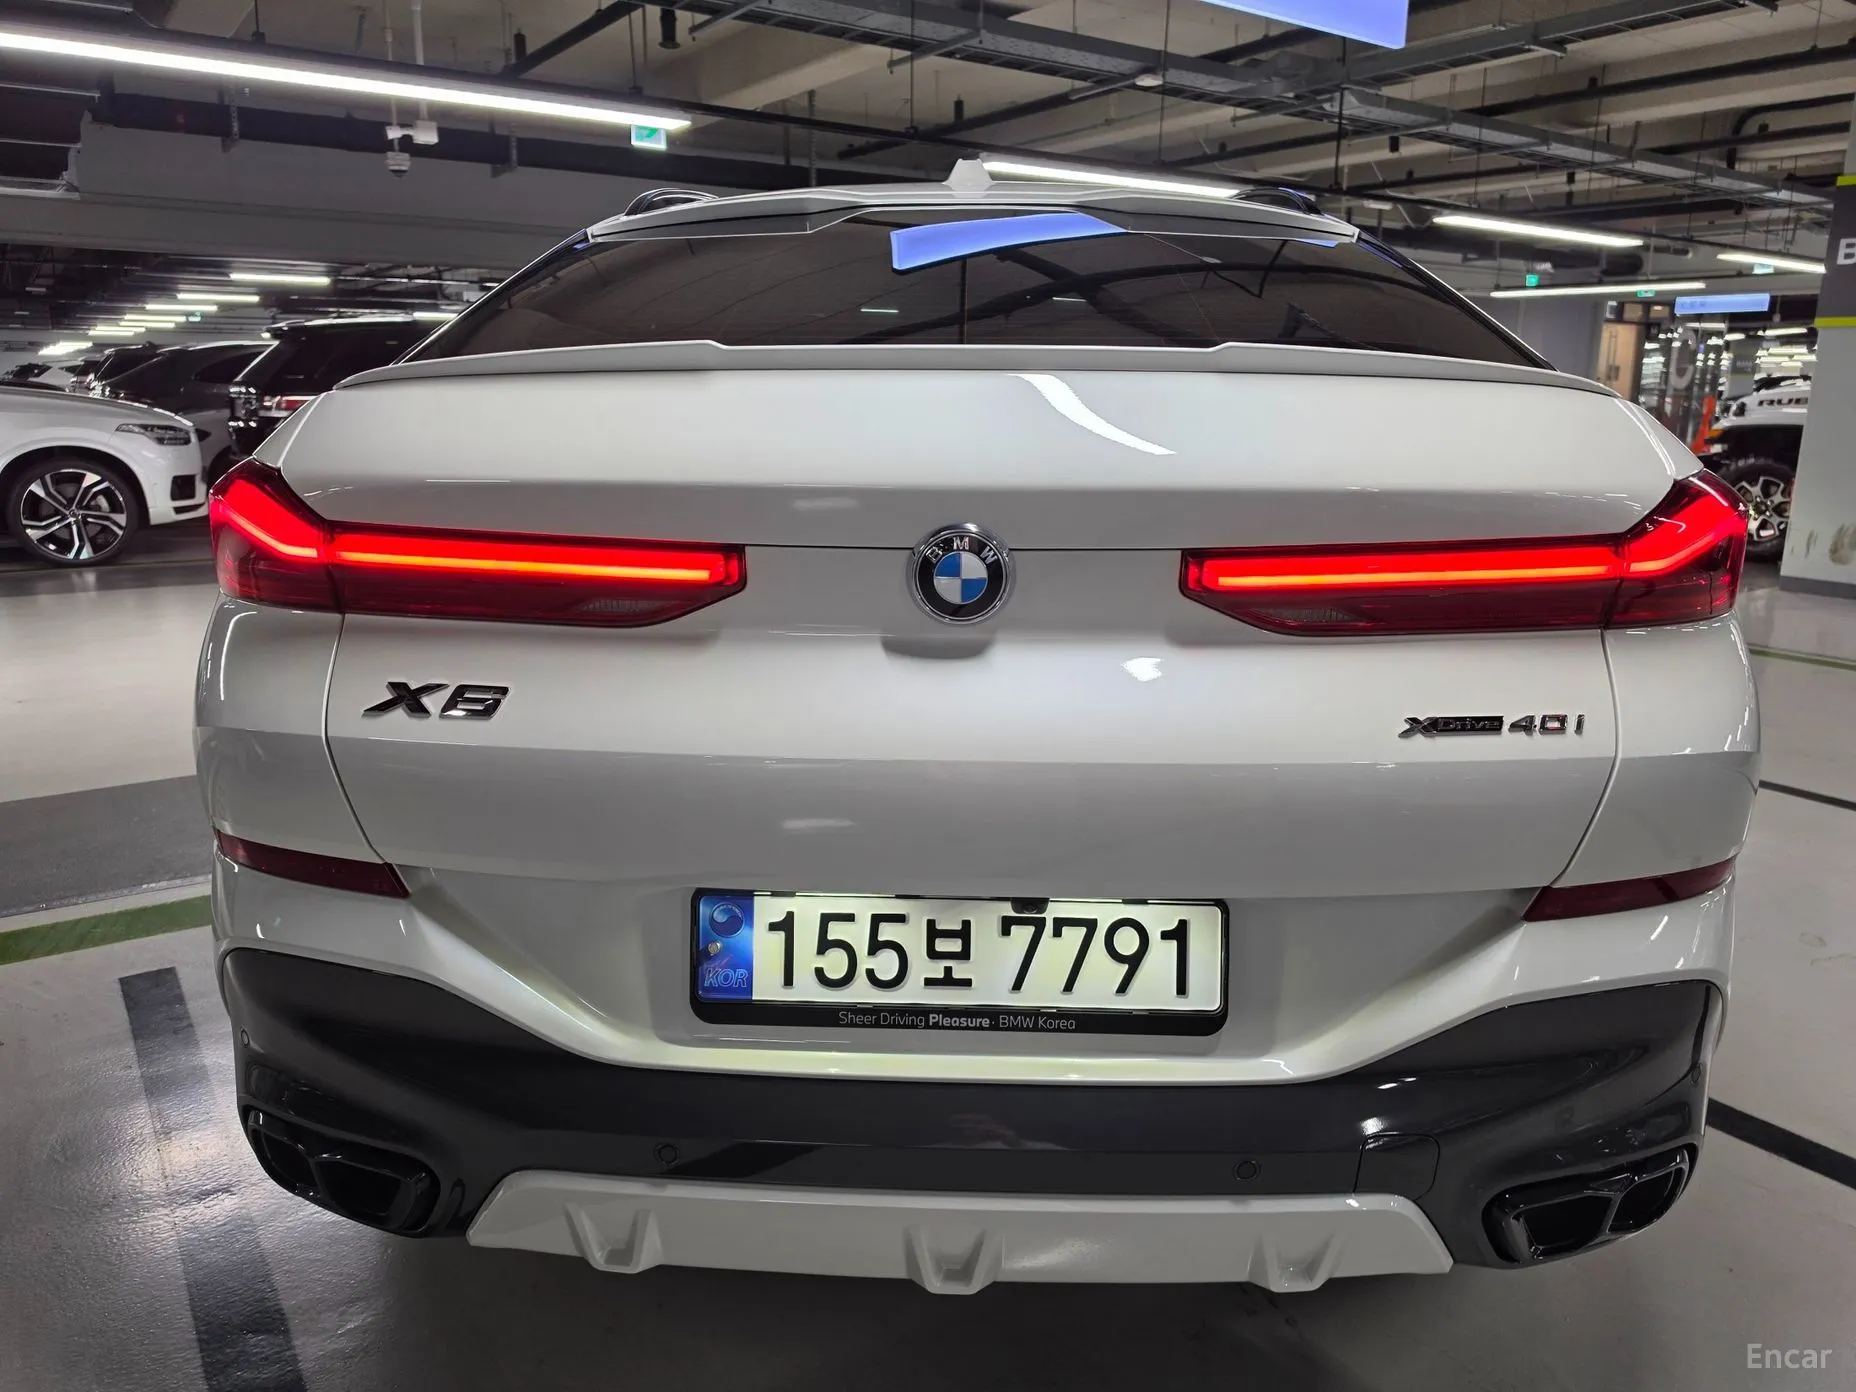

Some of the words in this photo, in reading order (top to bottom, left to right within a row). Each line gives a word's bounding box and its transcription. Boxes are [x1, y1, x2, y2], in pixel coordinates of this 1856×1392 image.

[925, 536, 998, 565] BMW
[361, 681, 510, 720] X6
[767, 910, 973, 989] 155보
[1000, 915, 1190, 997] 7791
[704, 968, 748, 988] KOR
[838, 1011, 877, 1025] Sheer
[880, 1012, 925, 1028] Driving
[999, 1015, 1034, 1029] BMW
[1038, 1016, 1076, 1030] Korea
